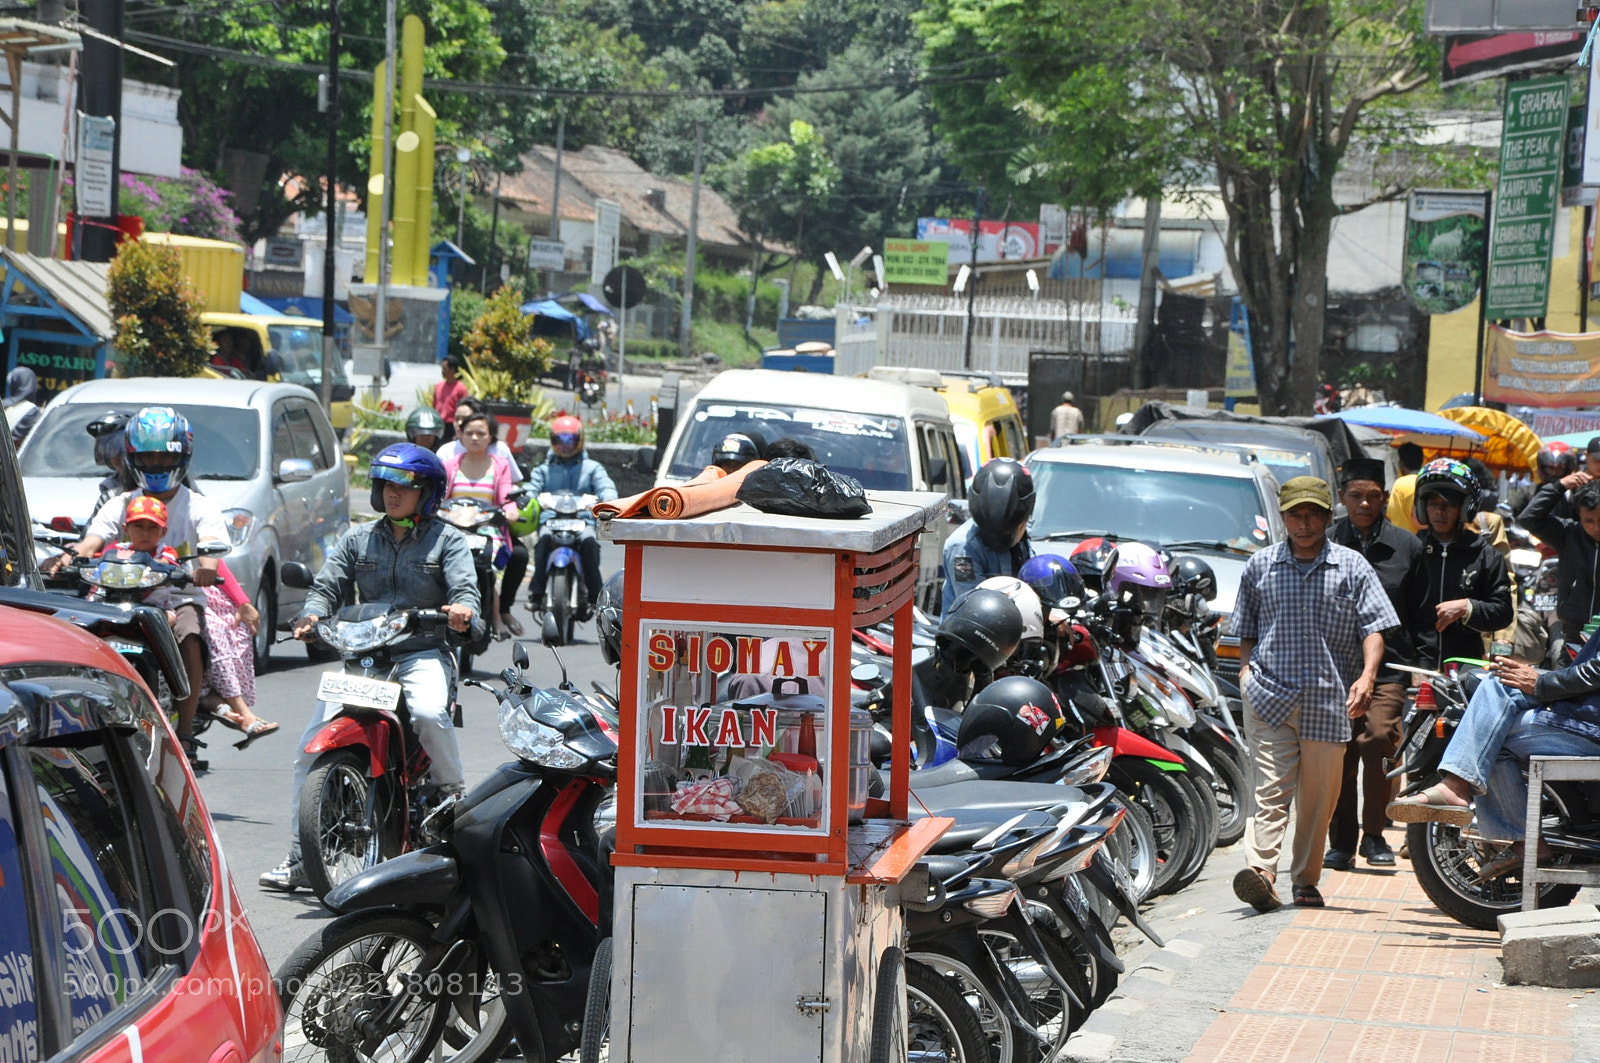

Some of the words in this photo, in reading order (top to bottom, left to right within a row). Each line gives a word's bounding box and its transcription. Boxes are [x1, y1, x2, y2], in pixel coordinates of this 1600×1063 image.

[1519, 90, 1564, 114] GRAFIKA
[1520, 110, 1559, 127] RESORT
[1505, 139, 1525, 159] THE
[1524, 136, 1552, 156] PEAK
[1502, 178, 1542, 197] KAMPUNG
[1498, 198, 1528, 217] GAJAH
[51, 355, 96, 371] TAHU
[975, 629, 1000, 652] HONDA
[648, 632, 828, 677] SIOMAY
[660, 705, 779, 747] IKAN
